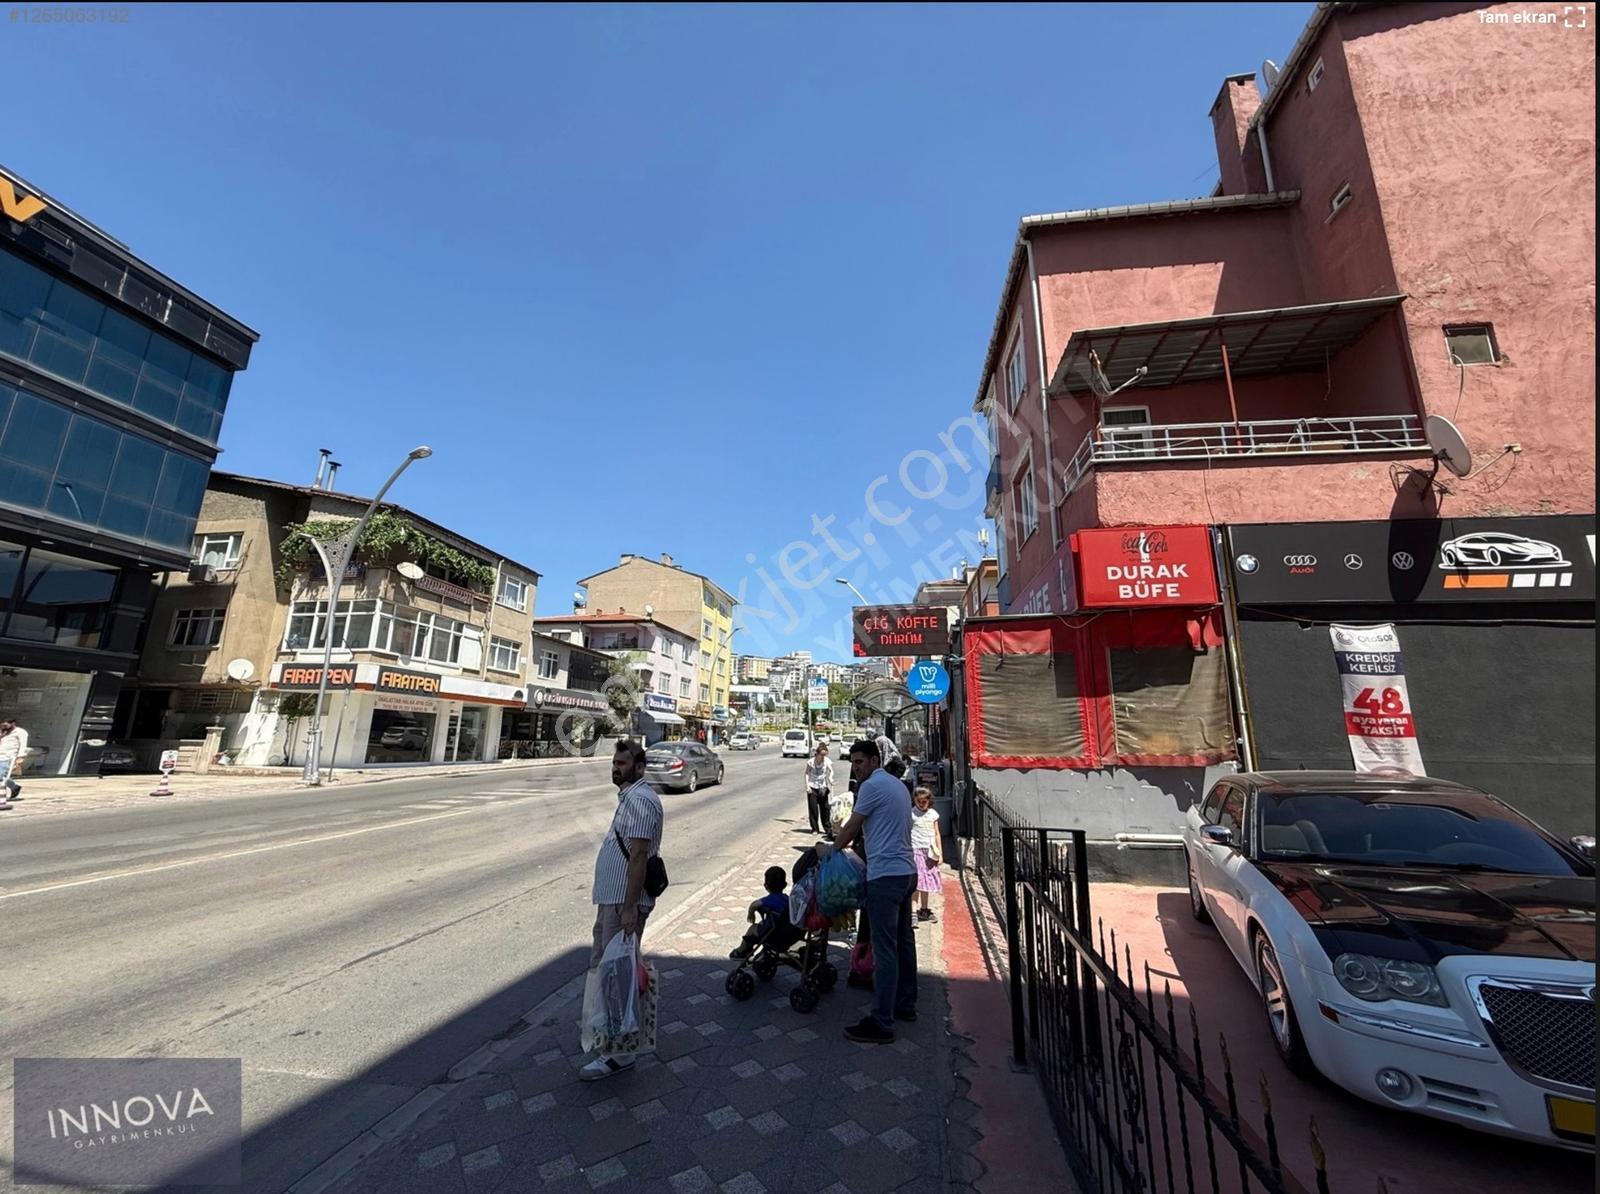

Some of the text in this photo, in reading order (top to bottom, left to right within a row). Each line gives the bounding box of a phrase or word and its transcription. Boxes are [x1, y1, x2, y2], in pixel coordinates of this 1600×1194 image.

[1107, 563, 1189, 580] DURAK
[1289, 566, 1315, 574] Audi
[1118, 580, 1181, 599] BÜFE
[880, 631, 923, 645] DÜRÜM
[1345, 652, 1397, 663] KREDİSİZ
[1350, 662, 1397, 673] KEFİLSİZ
[380, 671, 440, 693] FIRATPEN
[1352, 687, 1404, 715] 48
[1360, 724, 1405, 736] TAKSİT
